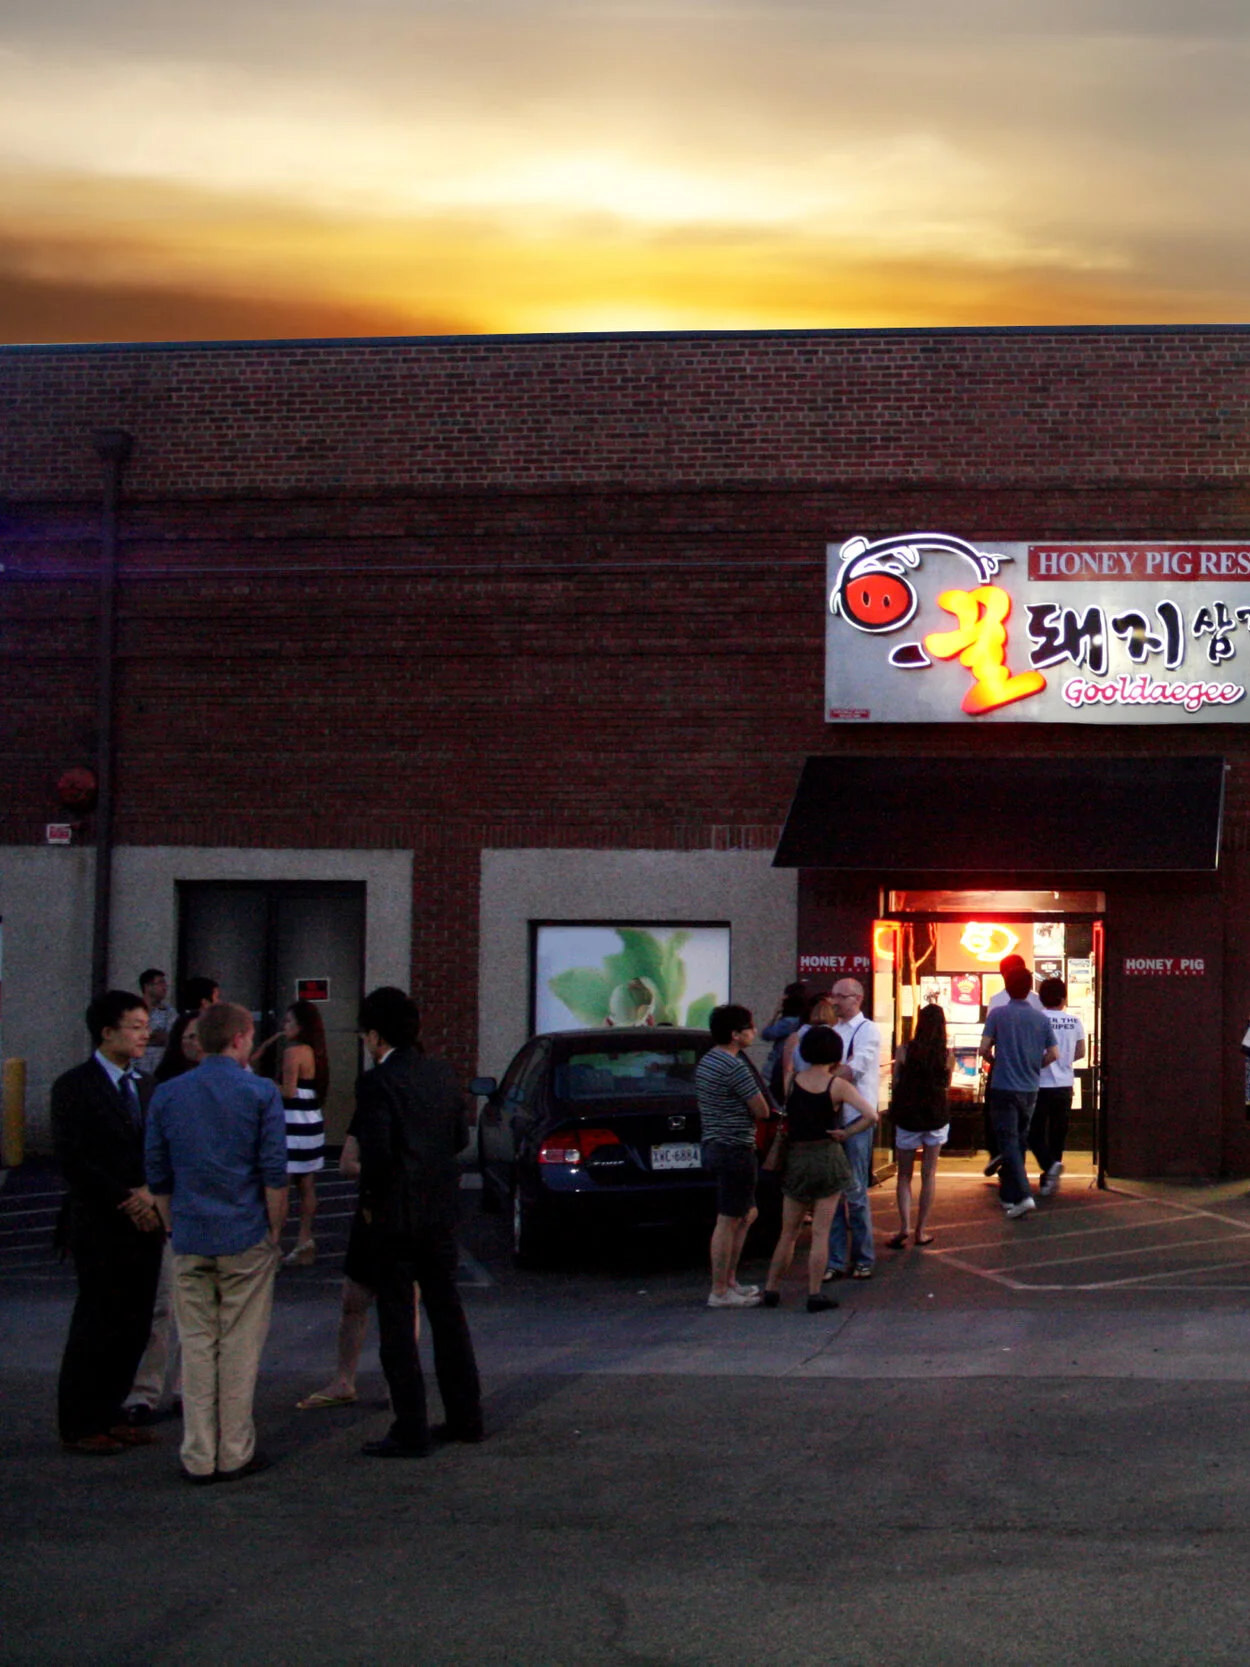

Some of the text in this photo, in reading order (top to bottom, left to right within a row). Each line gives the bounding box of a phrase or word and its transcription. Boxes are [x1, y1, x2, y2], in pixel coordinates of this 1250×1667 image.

[1038, 551, 1138, 575] HONEY
[1146, 551, 1193, 575] PIG
[1063, 675, 1244, 711] Gooldaegee
[800, 955, 847, 967] HONEY
[1126, 958, 1205, 970] HONEY PIG
